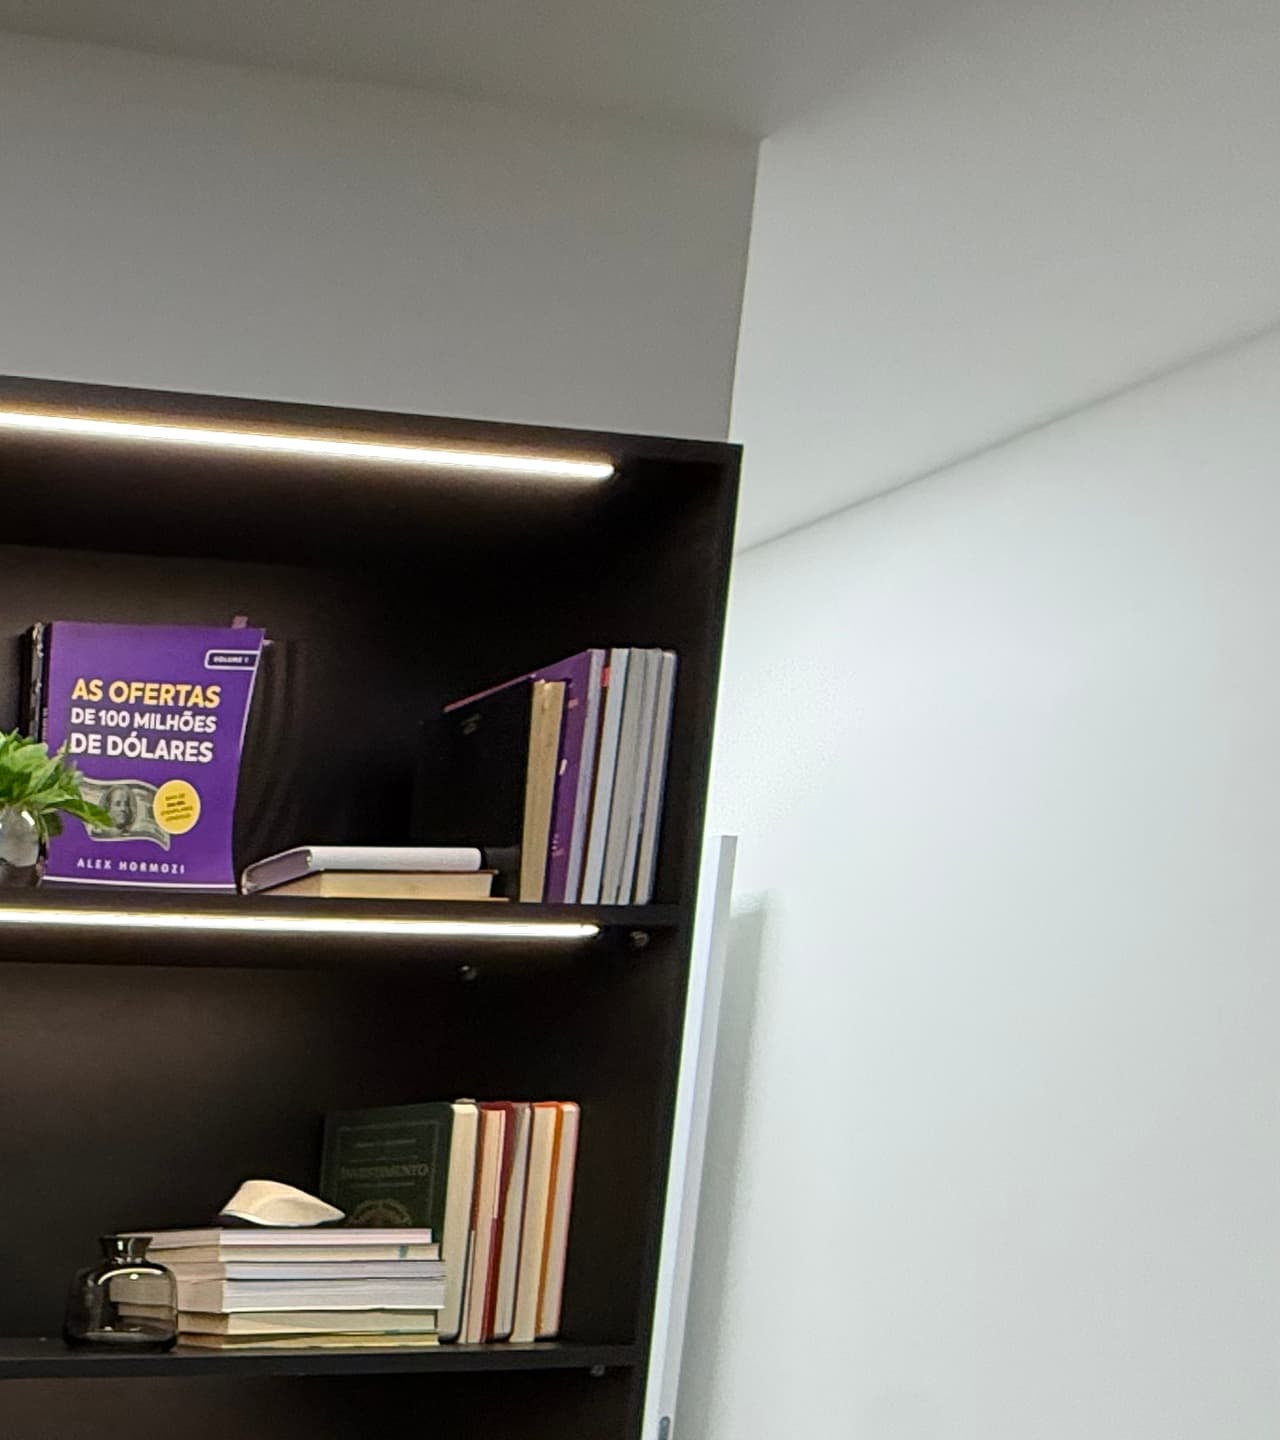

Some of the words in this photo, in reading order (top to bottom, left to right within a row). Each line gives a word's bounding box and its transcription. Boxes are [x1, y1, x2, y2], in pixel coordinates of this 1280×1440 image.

[71, 678, 103, 702] AS
[108, 680, 221, 708] OFERTAS
[71, 707, 96, 725] DE
[99, 710, 130, 728] 100
[134, 711, 217, 733] MILHÕES
[70, 733, 102, 754] DE
[107, 731, 214, 763] DÓLARES
[77, 858, 112, 870] ALEX
[119, 860, 185, 874] HORMOZI
